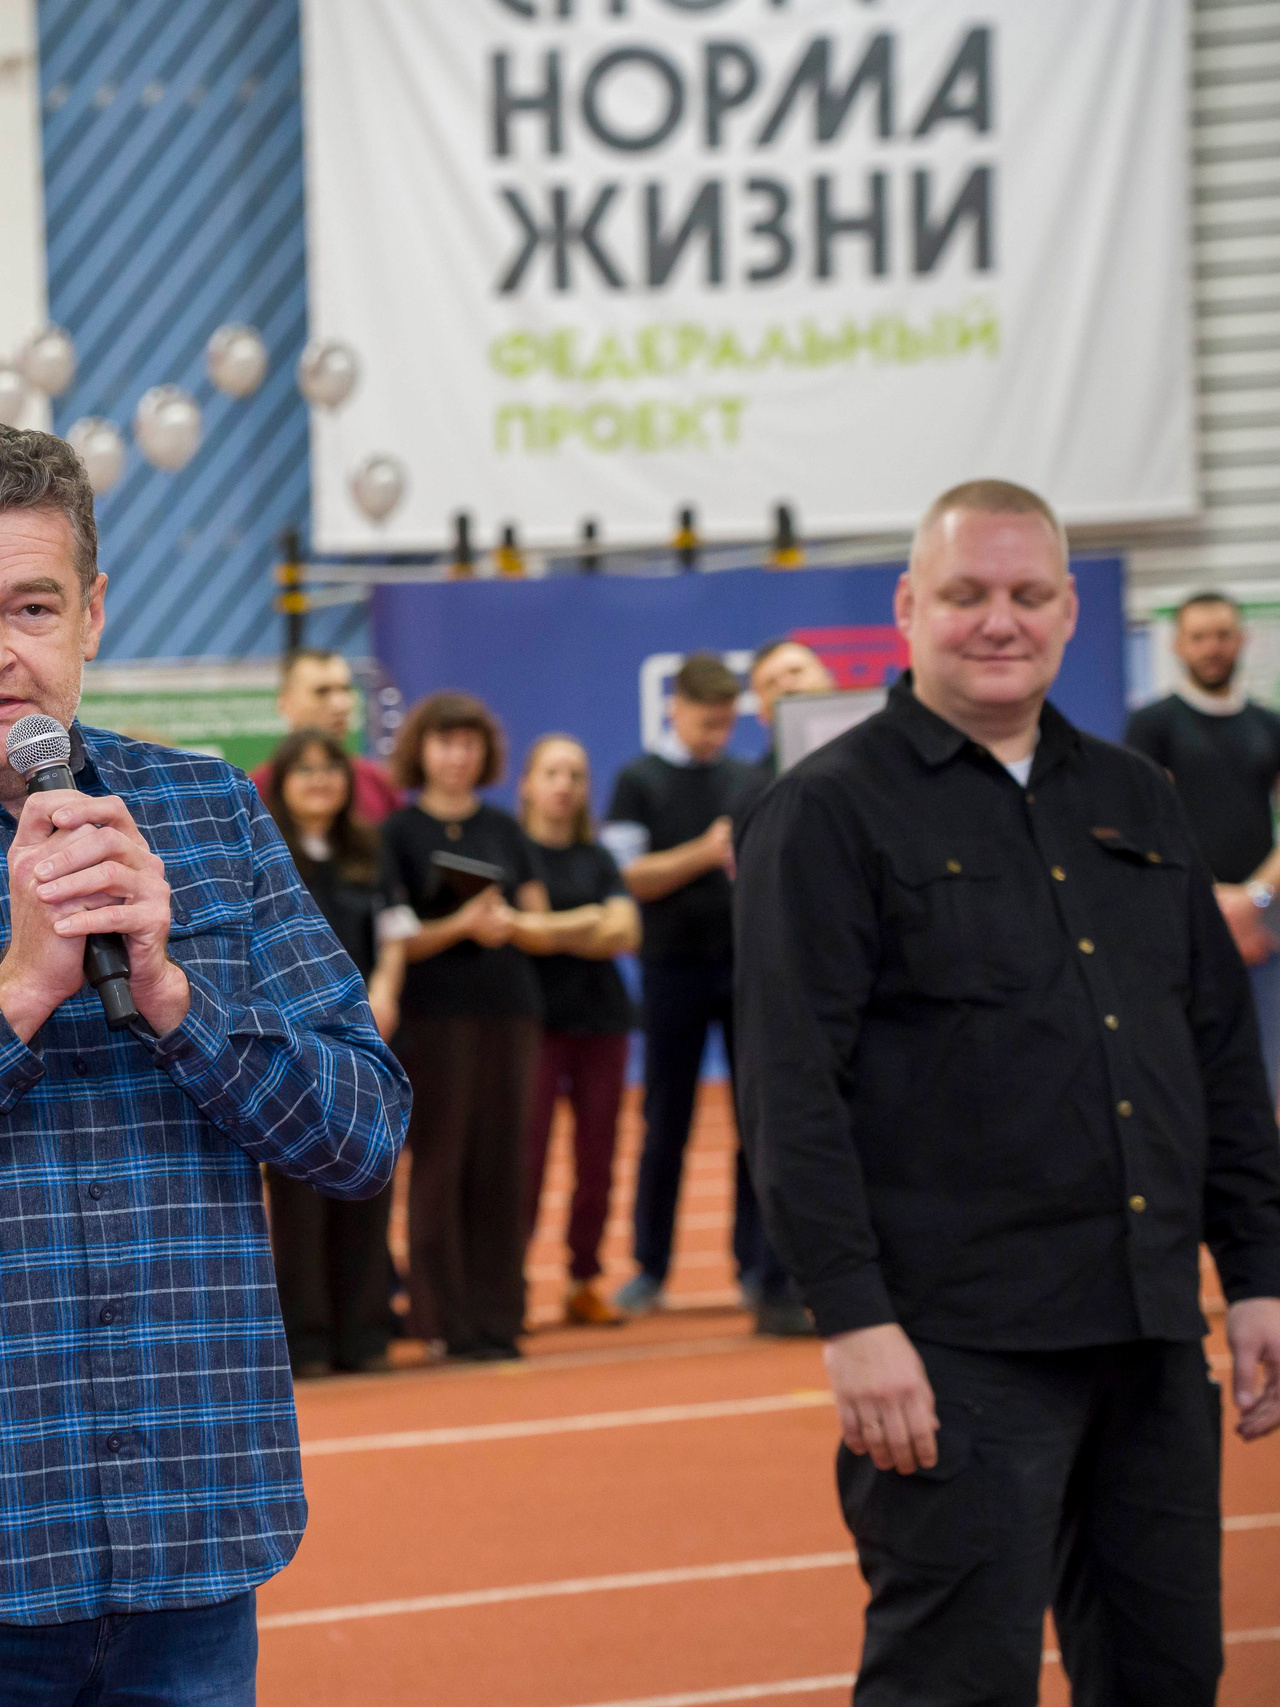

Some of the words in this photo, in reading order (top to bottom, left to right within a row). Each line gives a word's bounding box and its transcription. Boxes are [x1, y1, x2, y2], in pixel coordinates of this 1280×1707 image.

[491, 25, 993, 159] НОРМА
[495, 164, 994, 293] ЖИЗНИ
[489, 297, 999, 381] ФЕДЕРАЛЬНЫЙ
[494, 396, 744, 455] ПРОЕКТ
